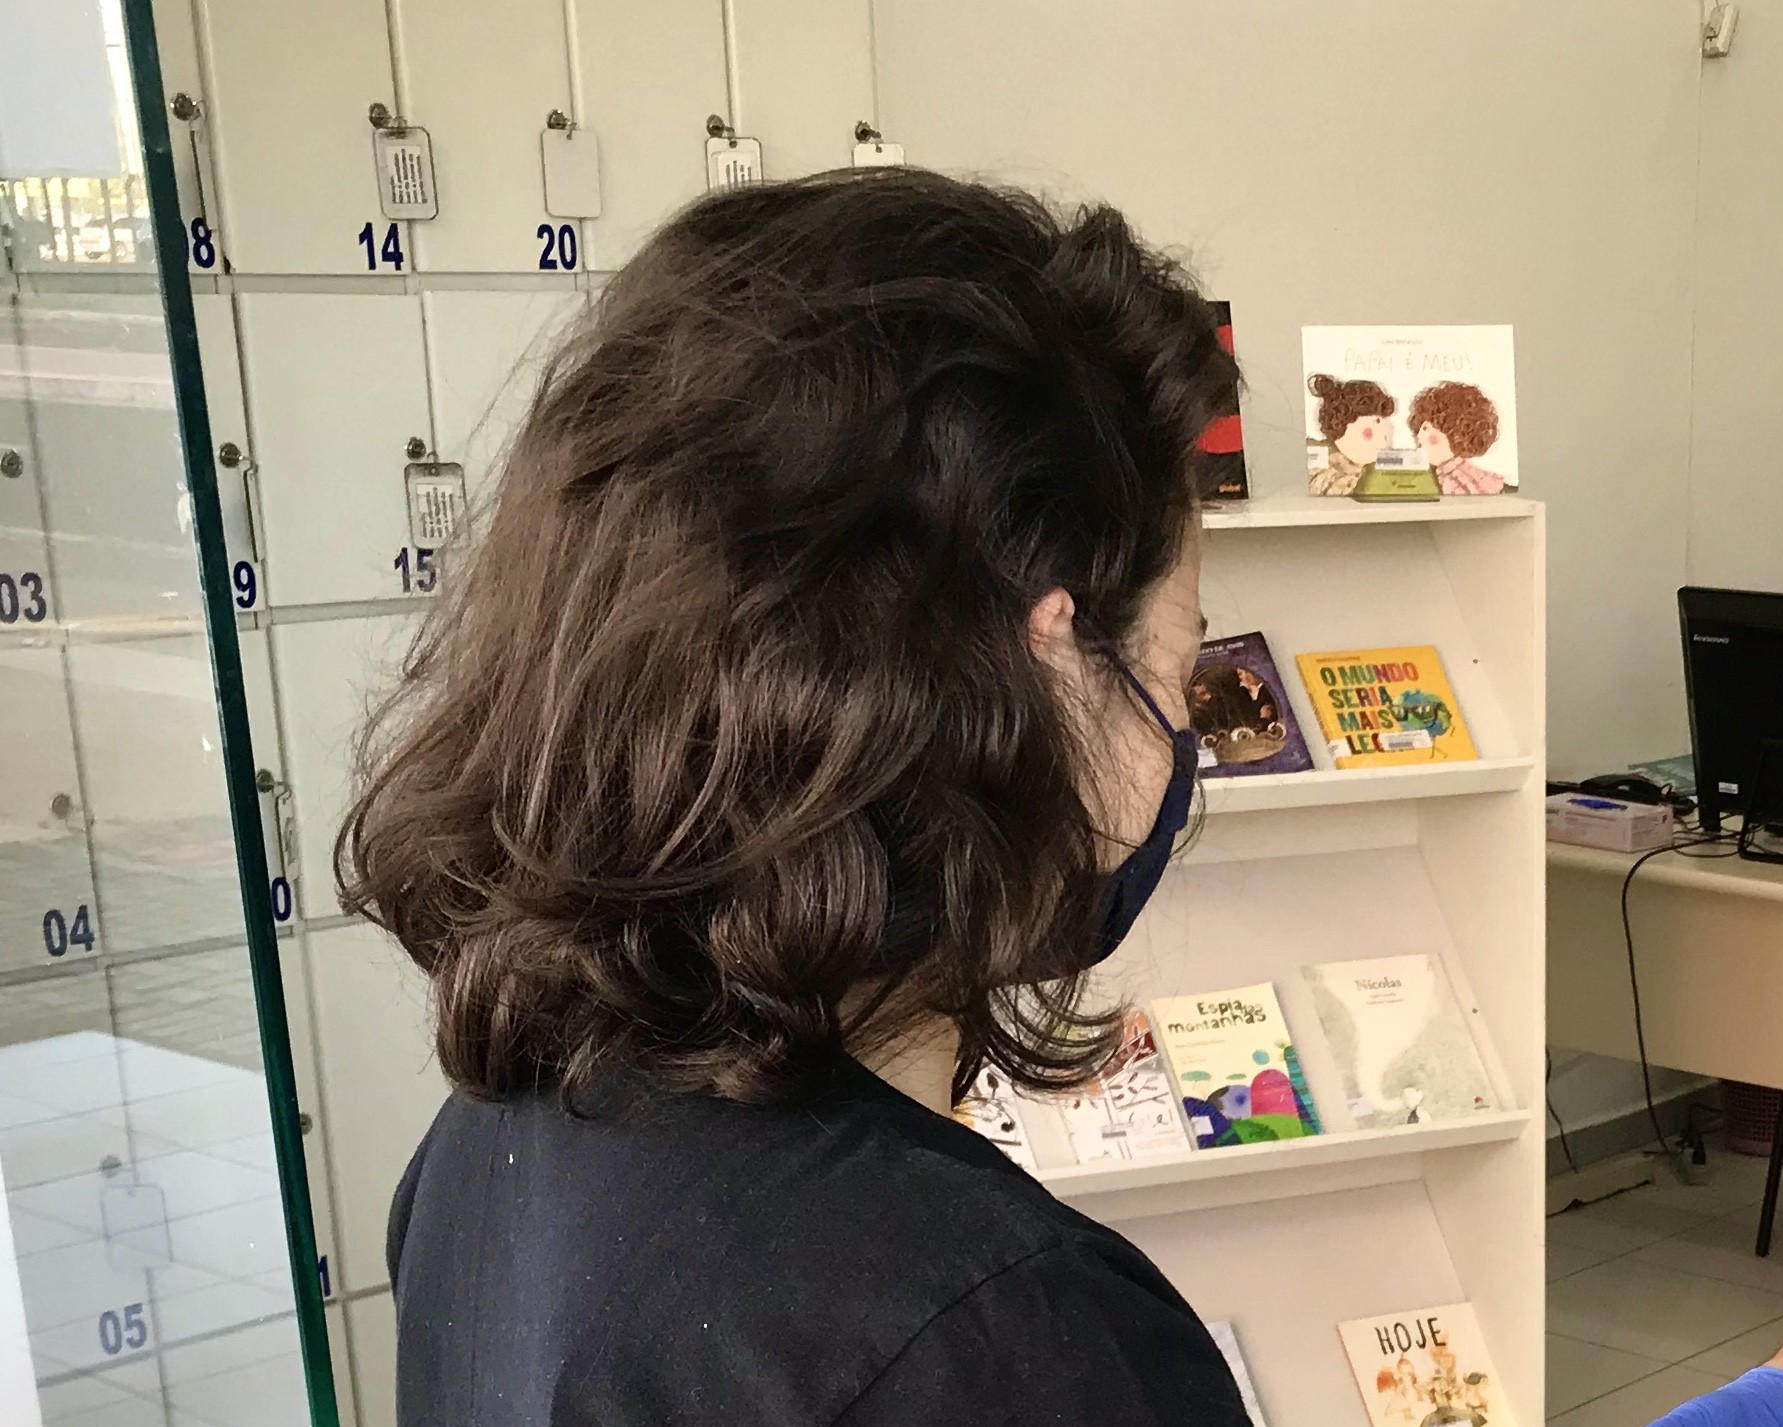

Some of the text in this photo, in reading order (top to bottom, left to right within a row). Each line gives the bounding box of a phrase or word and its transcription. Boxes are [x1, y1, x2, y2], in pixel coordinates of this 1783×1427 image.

[358, 221, 405, 272] 14
[536, 224, 579, 271] 20
[393, 547, 438, 592] 15
[0, 571, 48, 623] 03
[1318, 661, 1420, 687] O MUNDO
[1327, 684, 1393, 710] SERIA
[1336, 708, 1394, 733] MAIS
[42, 904, 96, 957] 04
[1167, 1010, 1267, 1034] montanhas
[98, 1302, 148, 1355] 05
[1373, 1317, 1447, 1356] HOJE
